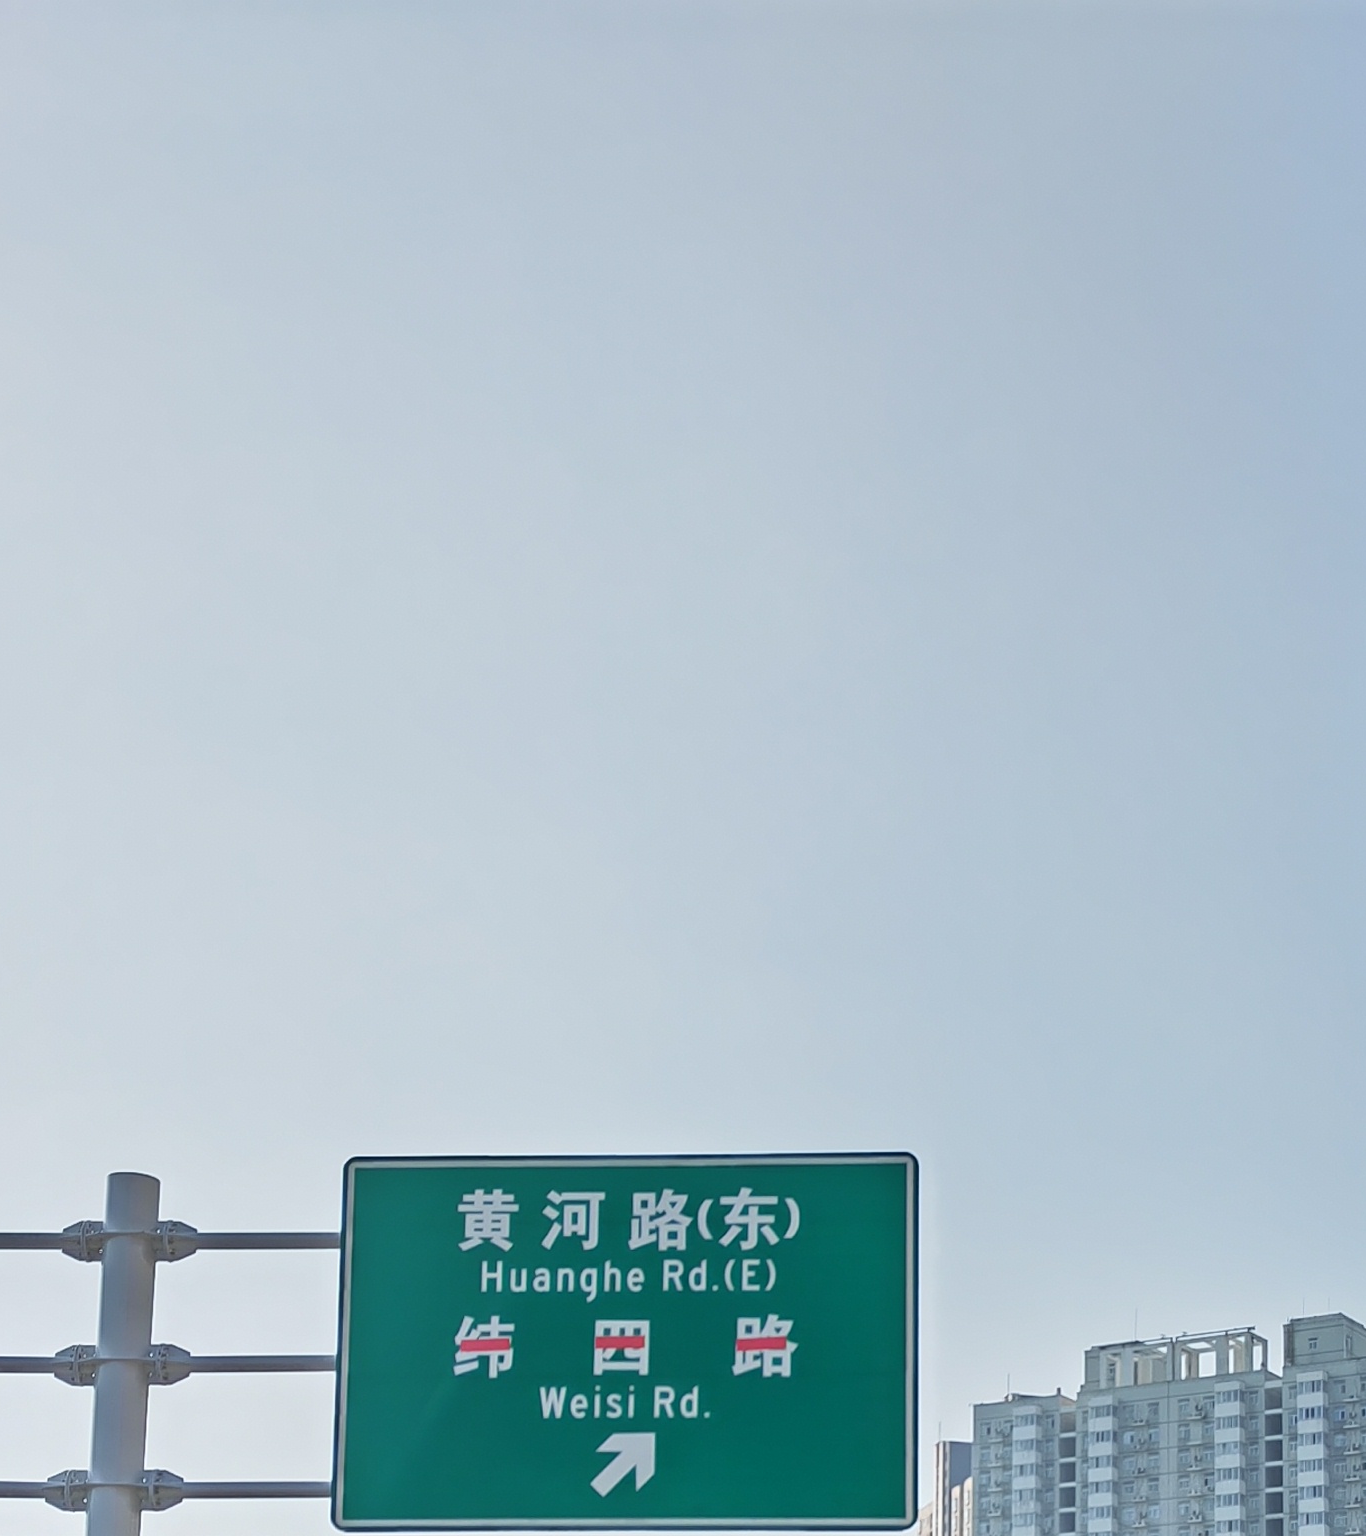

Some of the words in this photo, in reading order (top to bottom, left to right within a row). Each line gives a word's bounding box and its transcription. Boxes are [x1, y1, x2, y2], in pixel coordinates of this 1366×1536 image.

[480, 1260, 646, 1303] Huanghe
[539, 1385, 636, 1419] Weisi
[653, 1385, 711, 1419] Rd.
